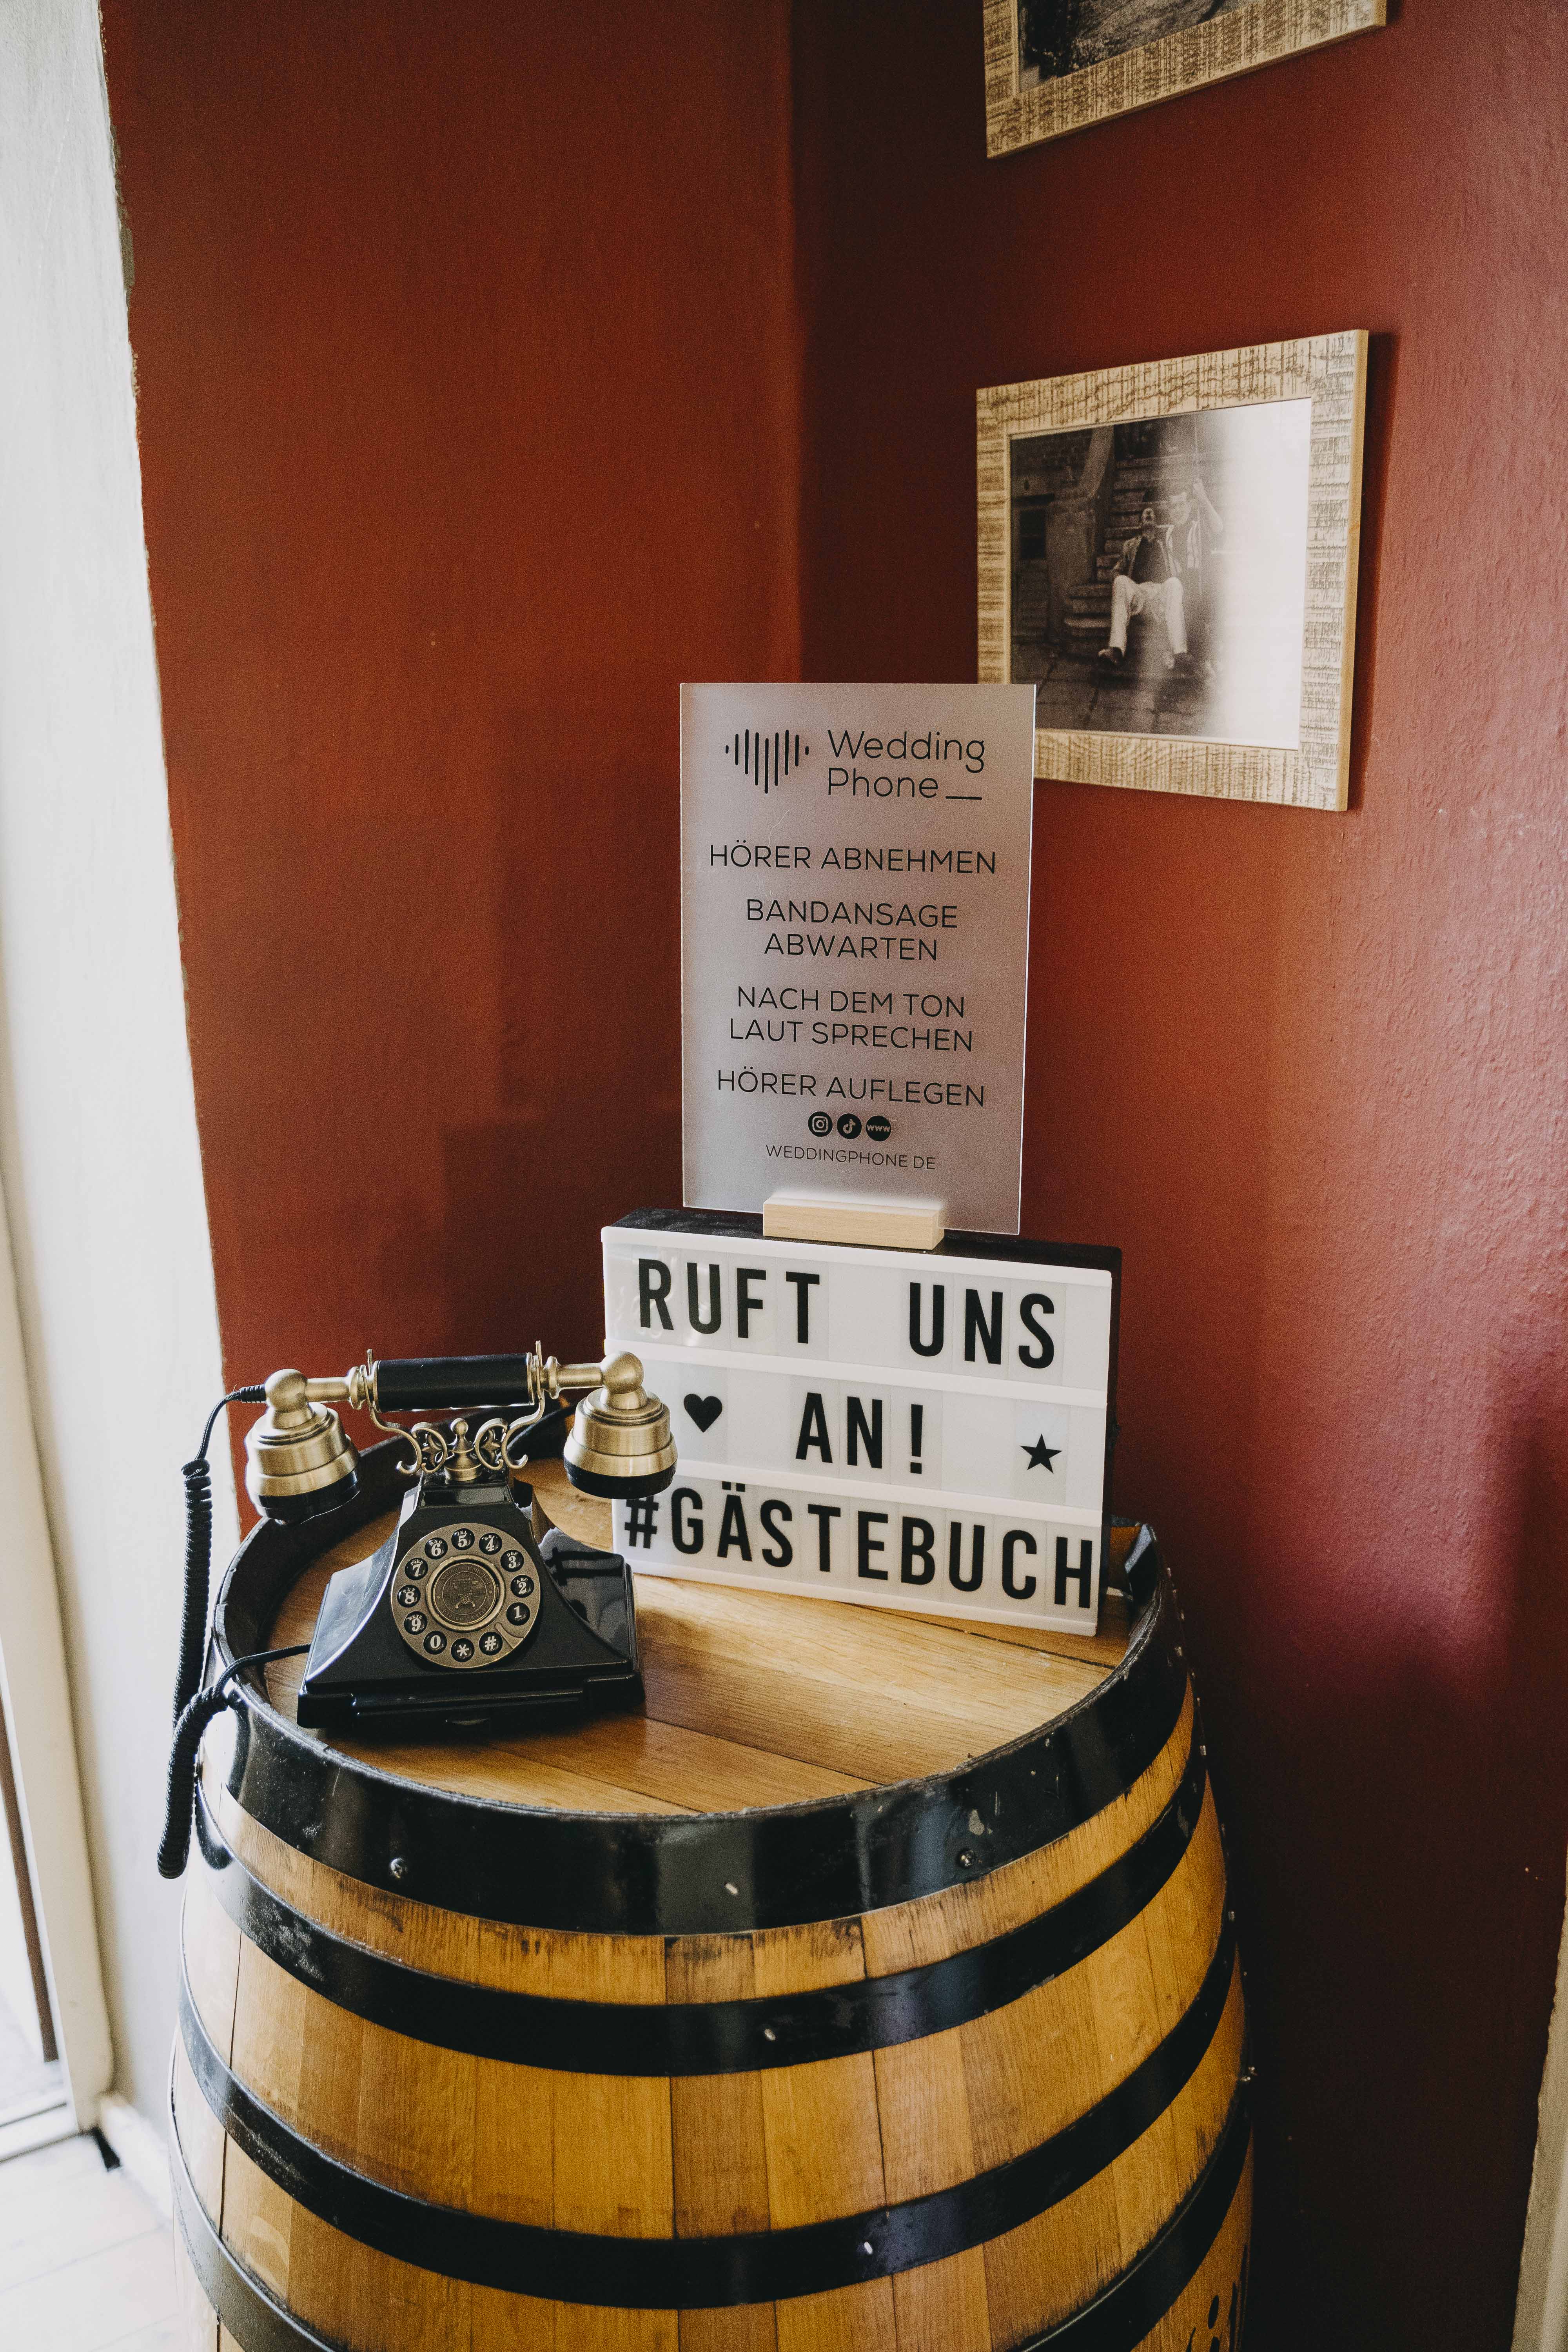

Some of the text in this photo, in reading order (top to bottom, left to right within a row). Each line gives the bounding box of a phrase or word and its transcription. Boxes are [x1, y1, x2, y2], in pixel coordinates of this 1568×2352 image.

[827, 729, 985, 773] Wedding
[710, 840, 996, 875] HÖRER ABNEHMEN
[747, 898, 958, 929] BANDANSAGE
[764, 933, 937, 961] ABWARTEN
[738, 985, 965, 1018] NACH DEM TON
[730, 1018, 973, 1053] LAUT SPRECHEN
[717, 1065, 984, 1107] HÖRER AUFLEGEN
[638, 1258, 1055, 1369] RUFT UNS
[795, 1392, 924, 1475] AN!
[431, 1543, 441, 1557] 6
[458, 1534, 467, 1547] 5
[486, 1537, 495, 1552] 4
[624, 1480, 1093, 1609] #GÄSTEBUCH
[412, 1563, 421, 1577] 7
[508, 1556, 517, 1568] 3
[405, 1591, 415, 1604] 8
[518, 1581, 527, 1594] 2
[412, 1618, 421, 1631] 9
[514, 1605, 522, 1619] 1
